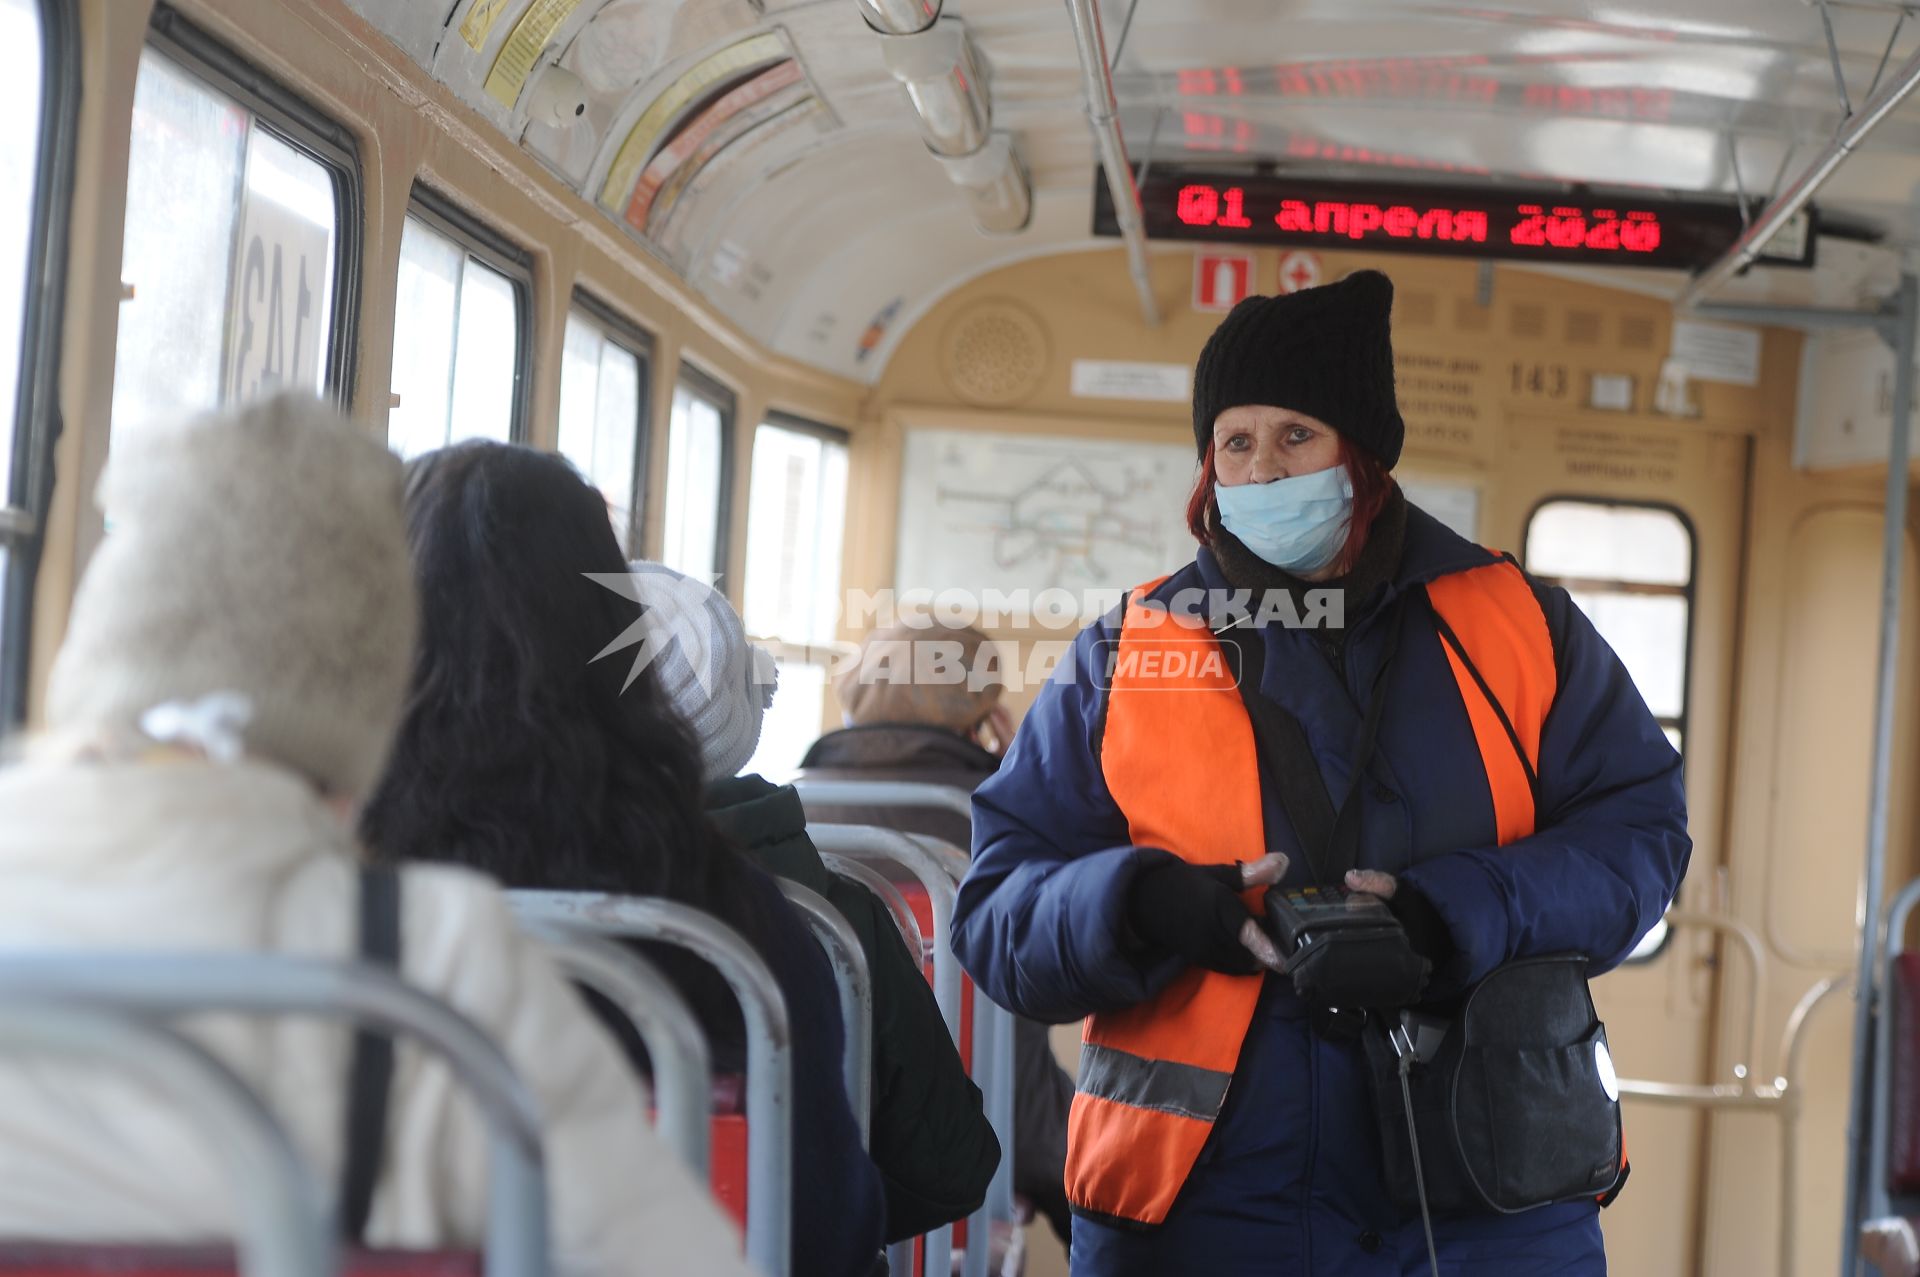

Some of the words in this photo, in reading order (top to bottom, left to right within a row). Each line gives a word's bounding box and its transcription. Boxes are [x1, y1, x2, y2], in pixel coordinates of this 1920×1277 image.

[1176, 184, 1251, 228] 01
[1274, 200, 1488, 242] апреля
[1509, 204, 1660, 252] 2020
[1508, 361, 1568, 398] 143
